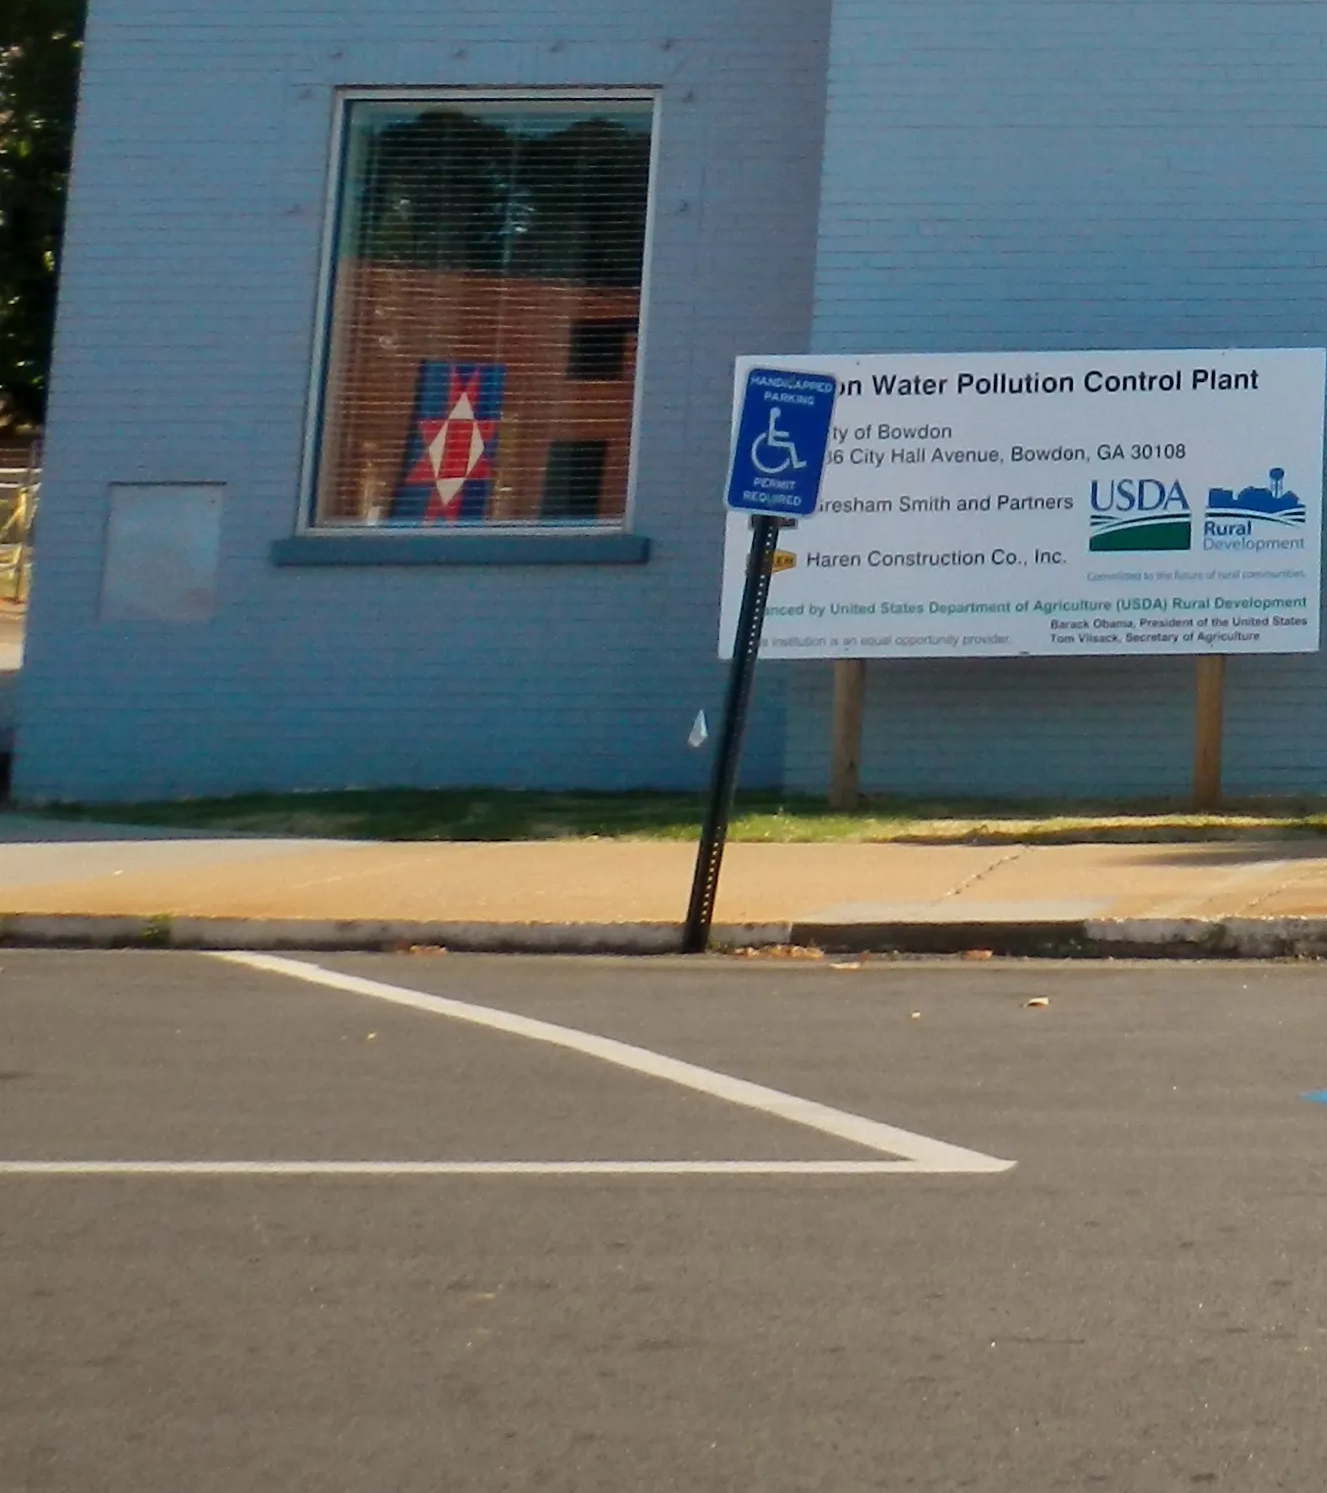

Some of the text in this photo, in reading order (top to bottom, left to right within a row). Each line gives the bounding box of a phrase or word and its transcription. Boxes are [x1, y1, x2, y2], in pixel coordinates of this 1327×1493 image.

[750, 377, 833, 394] HANDICAPPED
[872, 374, 948, 395] Water
[957, 371, 1074, 394] Pollution
[1084, 369, 1182, 392] Control
[1191, 368, 1259, 390] Plant
[763, 392, 815, 406] PARKING
[832, 423, 952, 443] ty of Bowdon
[850, 447, 884, 468] City
[891, 447, 926, 463] Hall
[931, 447, 1004, 465] Avenue,
[1011, 445, 1090, 463] Bowdon,
[1097, 444, 1125, 460] GA
[1131, 443, 1187, 459] 30108
[753, 477, 796, 490] PERMIT
[742, 490, 803, 506] REQUIRED
[1089, 478, 1191, 512] USDA
[819, 494, 1074, 513] resham Smith and Partners
[1203, 520, 1252, 535] Rural
[1203, 536, 1305, 552] Development
[806, 551, 861, 567] Haren
[867, 550, 985, 567] Construction
[991, 549, 1027, 567] Co.,
[1035, 548, 1067, 564] Inc.
[763, 596, 1307, 618] anced by United States Department of Agriculture (USDA) Rural Development
[1051, 615, 1308, 630] Barack Obama, President of the United States
[843, 637, 857, 647] an
[1050, 633, 1075, 644] Tom
[1125, 631, 1179, 645] Secretary
[1182, 631, 1194, 642] of
[1197, 630, 1261, 645] Agriculture
